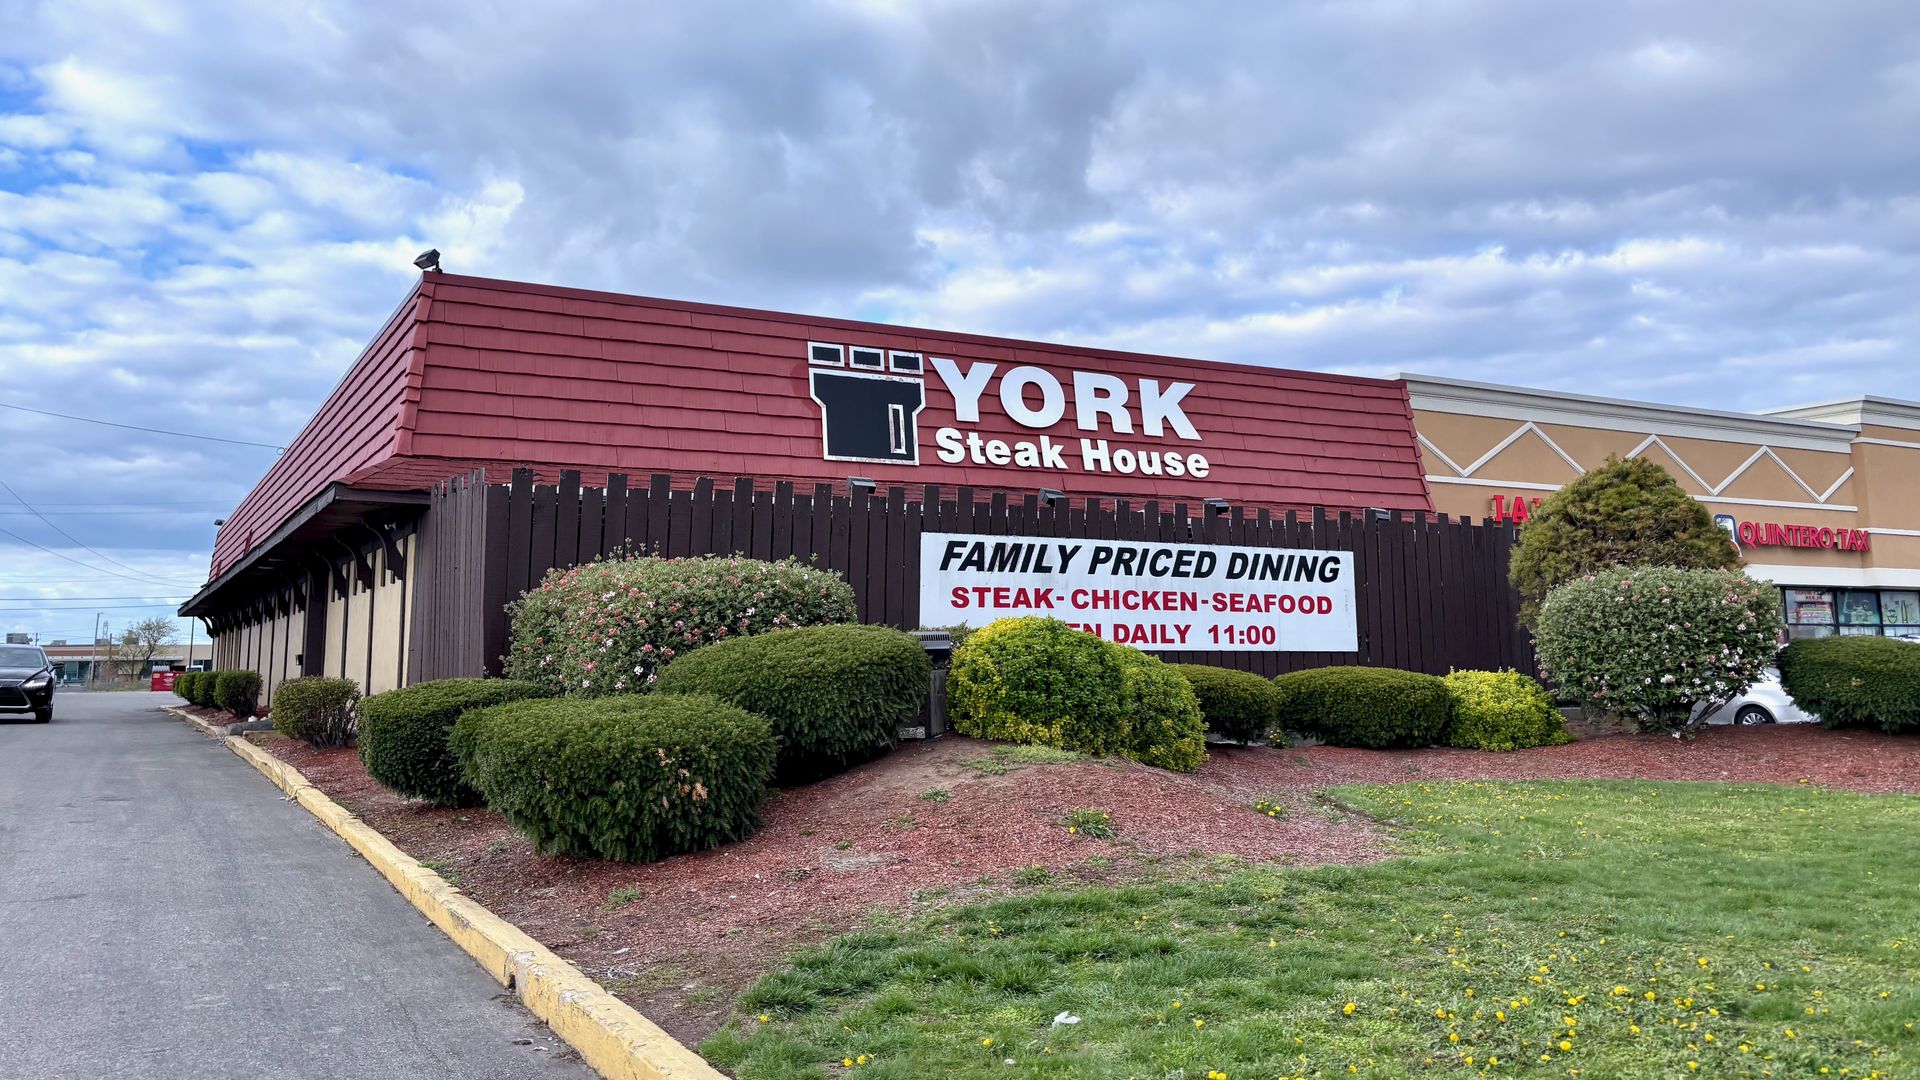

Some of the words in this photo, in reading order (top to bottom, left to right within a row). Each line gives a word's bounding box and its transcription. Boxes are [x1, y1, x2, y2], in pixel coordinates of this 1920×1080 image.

[928, 356, 1203, 441] YORK
[935, 427, 1068, 470] Steak
[1081, 438, 1210, 479] House
[1738, 521, 1835, 550] QUINTERO
[1836, 528, 1871, 552] TAX
[939, 540, 1083, 574] FAMILY
[1087, 546, 1217, 578] PRICED
[1226, 552, 1341, 583] DINING
[1112, 623, 1193, 644] DAILY
[1207, 624, 1276, 645] 11:00
